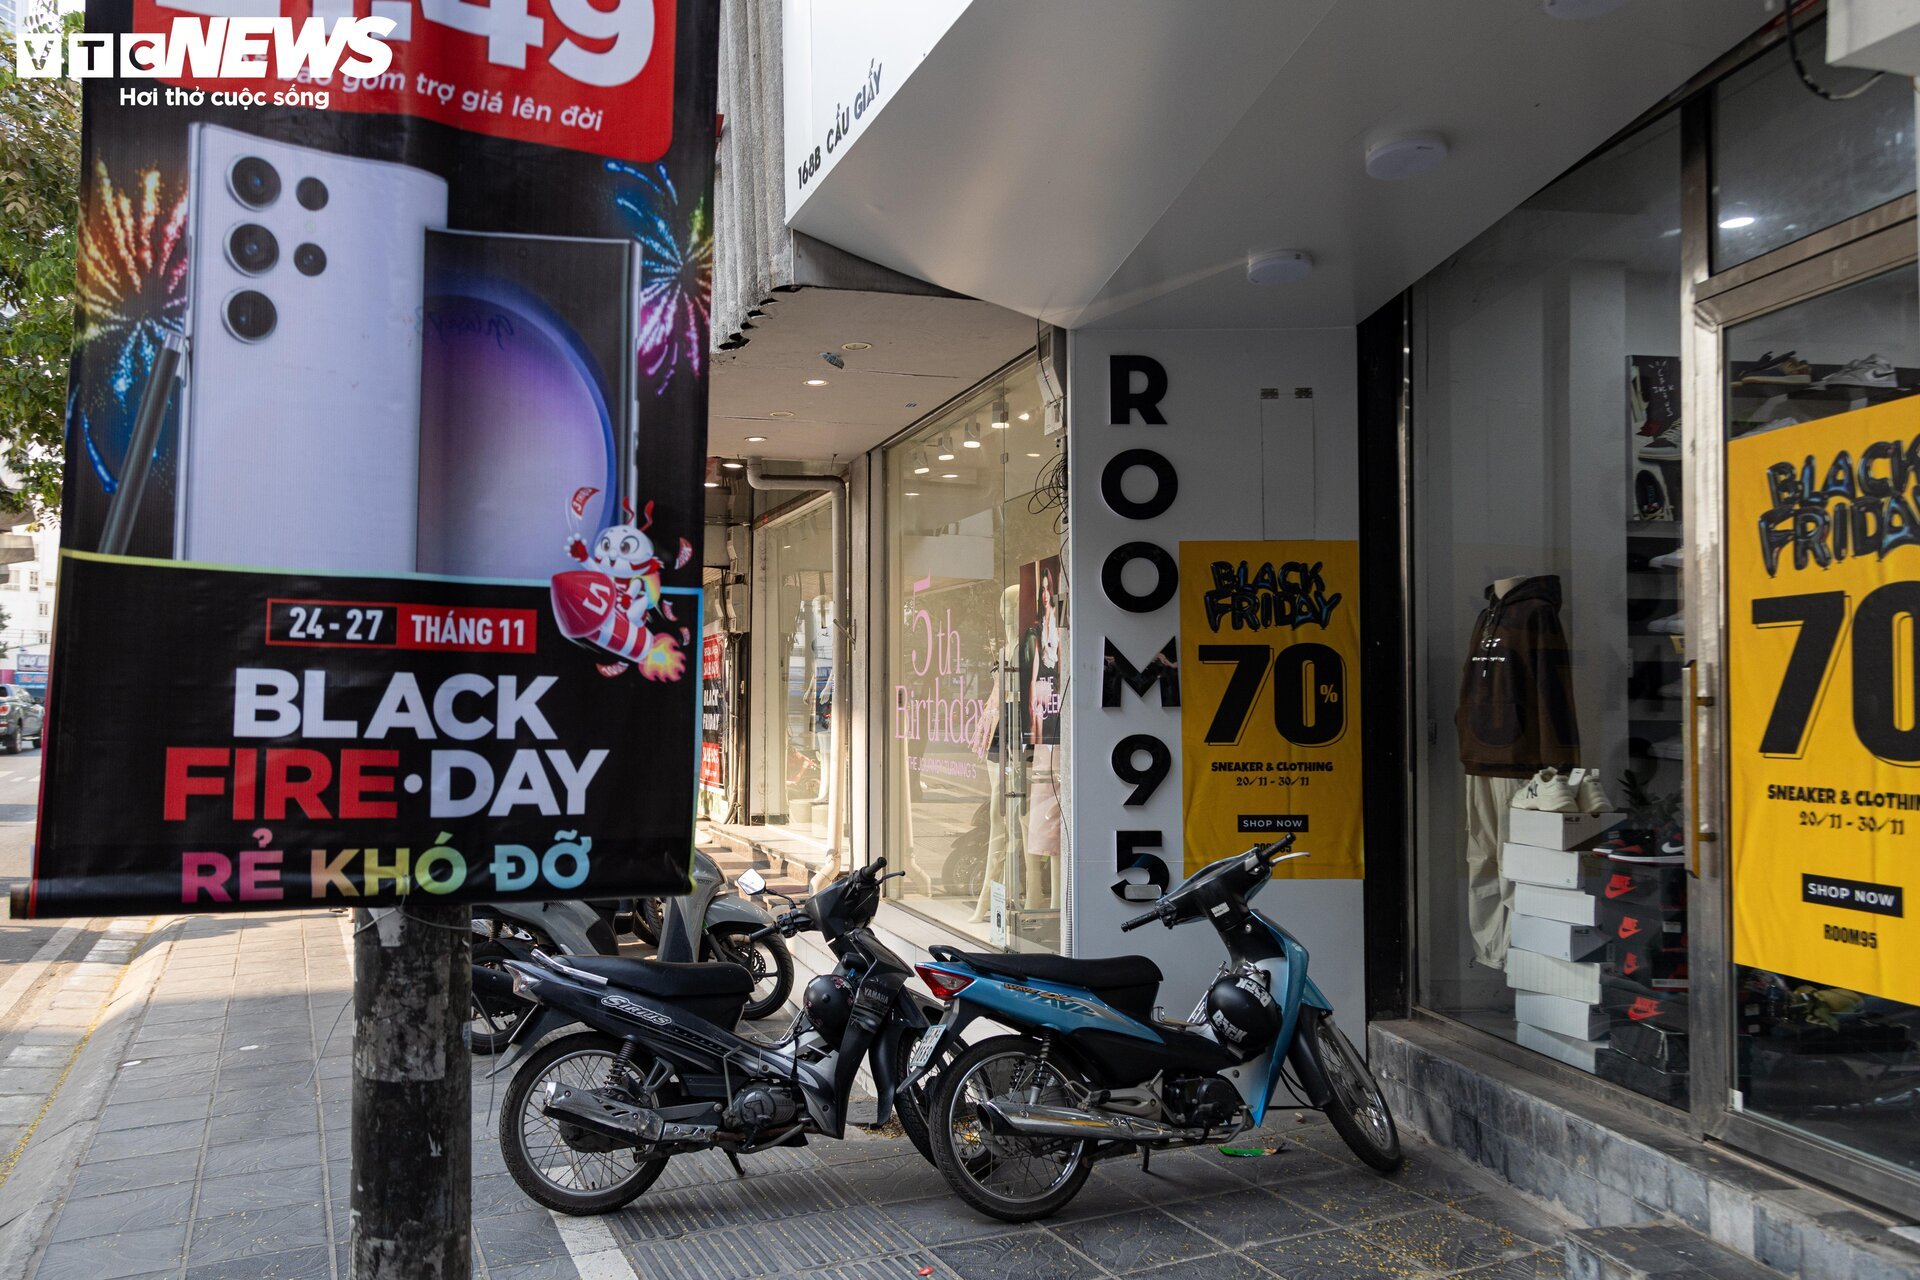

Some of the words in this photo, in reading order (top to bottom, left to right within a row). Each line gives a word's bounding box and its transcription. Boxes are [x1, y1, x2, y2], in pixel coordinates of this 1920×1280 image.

[416, 72, 455, 103] trợ
[461, 85, 504, 114] giá
[512, 95, 552, 123] lên
[560, 105, 604, 132] đời
[798, 145, 821, 190] 168B
[1210, 560, 1326, 596] BLACK
[411, 610, 493, 646] THÁNG
[499, 617, 525, 647] 11
[1204, 589, 1343, 634] FRIDAY
[233, 667, 559, 741] BLACK
[895, 676, 994, 760] Birthday
[1211, 761, 1264, 772] SNEAKER
[1265, 762, 1274, 772] &
[1276, 761, 1334, 772] CLOTHING
[1767, 784, 1836, 804] SNEAKER
[1840, 790, 1852, 805] &
[1242, 819, 1273, 828] SHOP
[1276, 820, 1303, 828] NOW
[181, 828, 284, 904] RẺ
[310, 830, 468, 899] KHÓ
[488, 828, 593, 893] ĐỠ
[1807, 882, 1851, 900] SHOP
[1854, 889, 1896, 907] NOW
[1823, 922, 1878, 949] ROOM95
[864, 987, 889, 1005] YAMAHA
